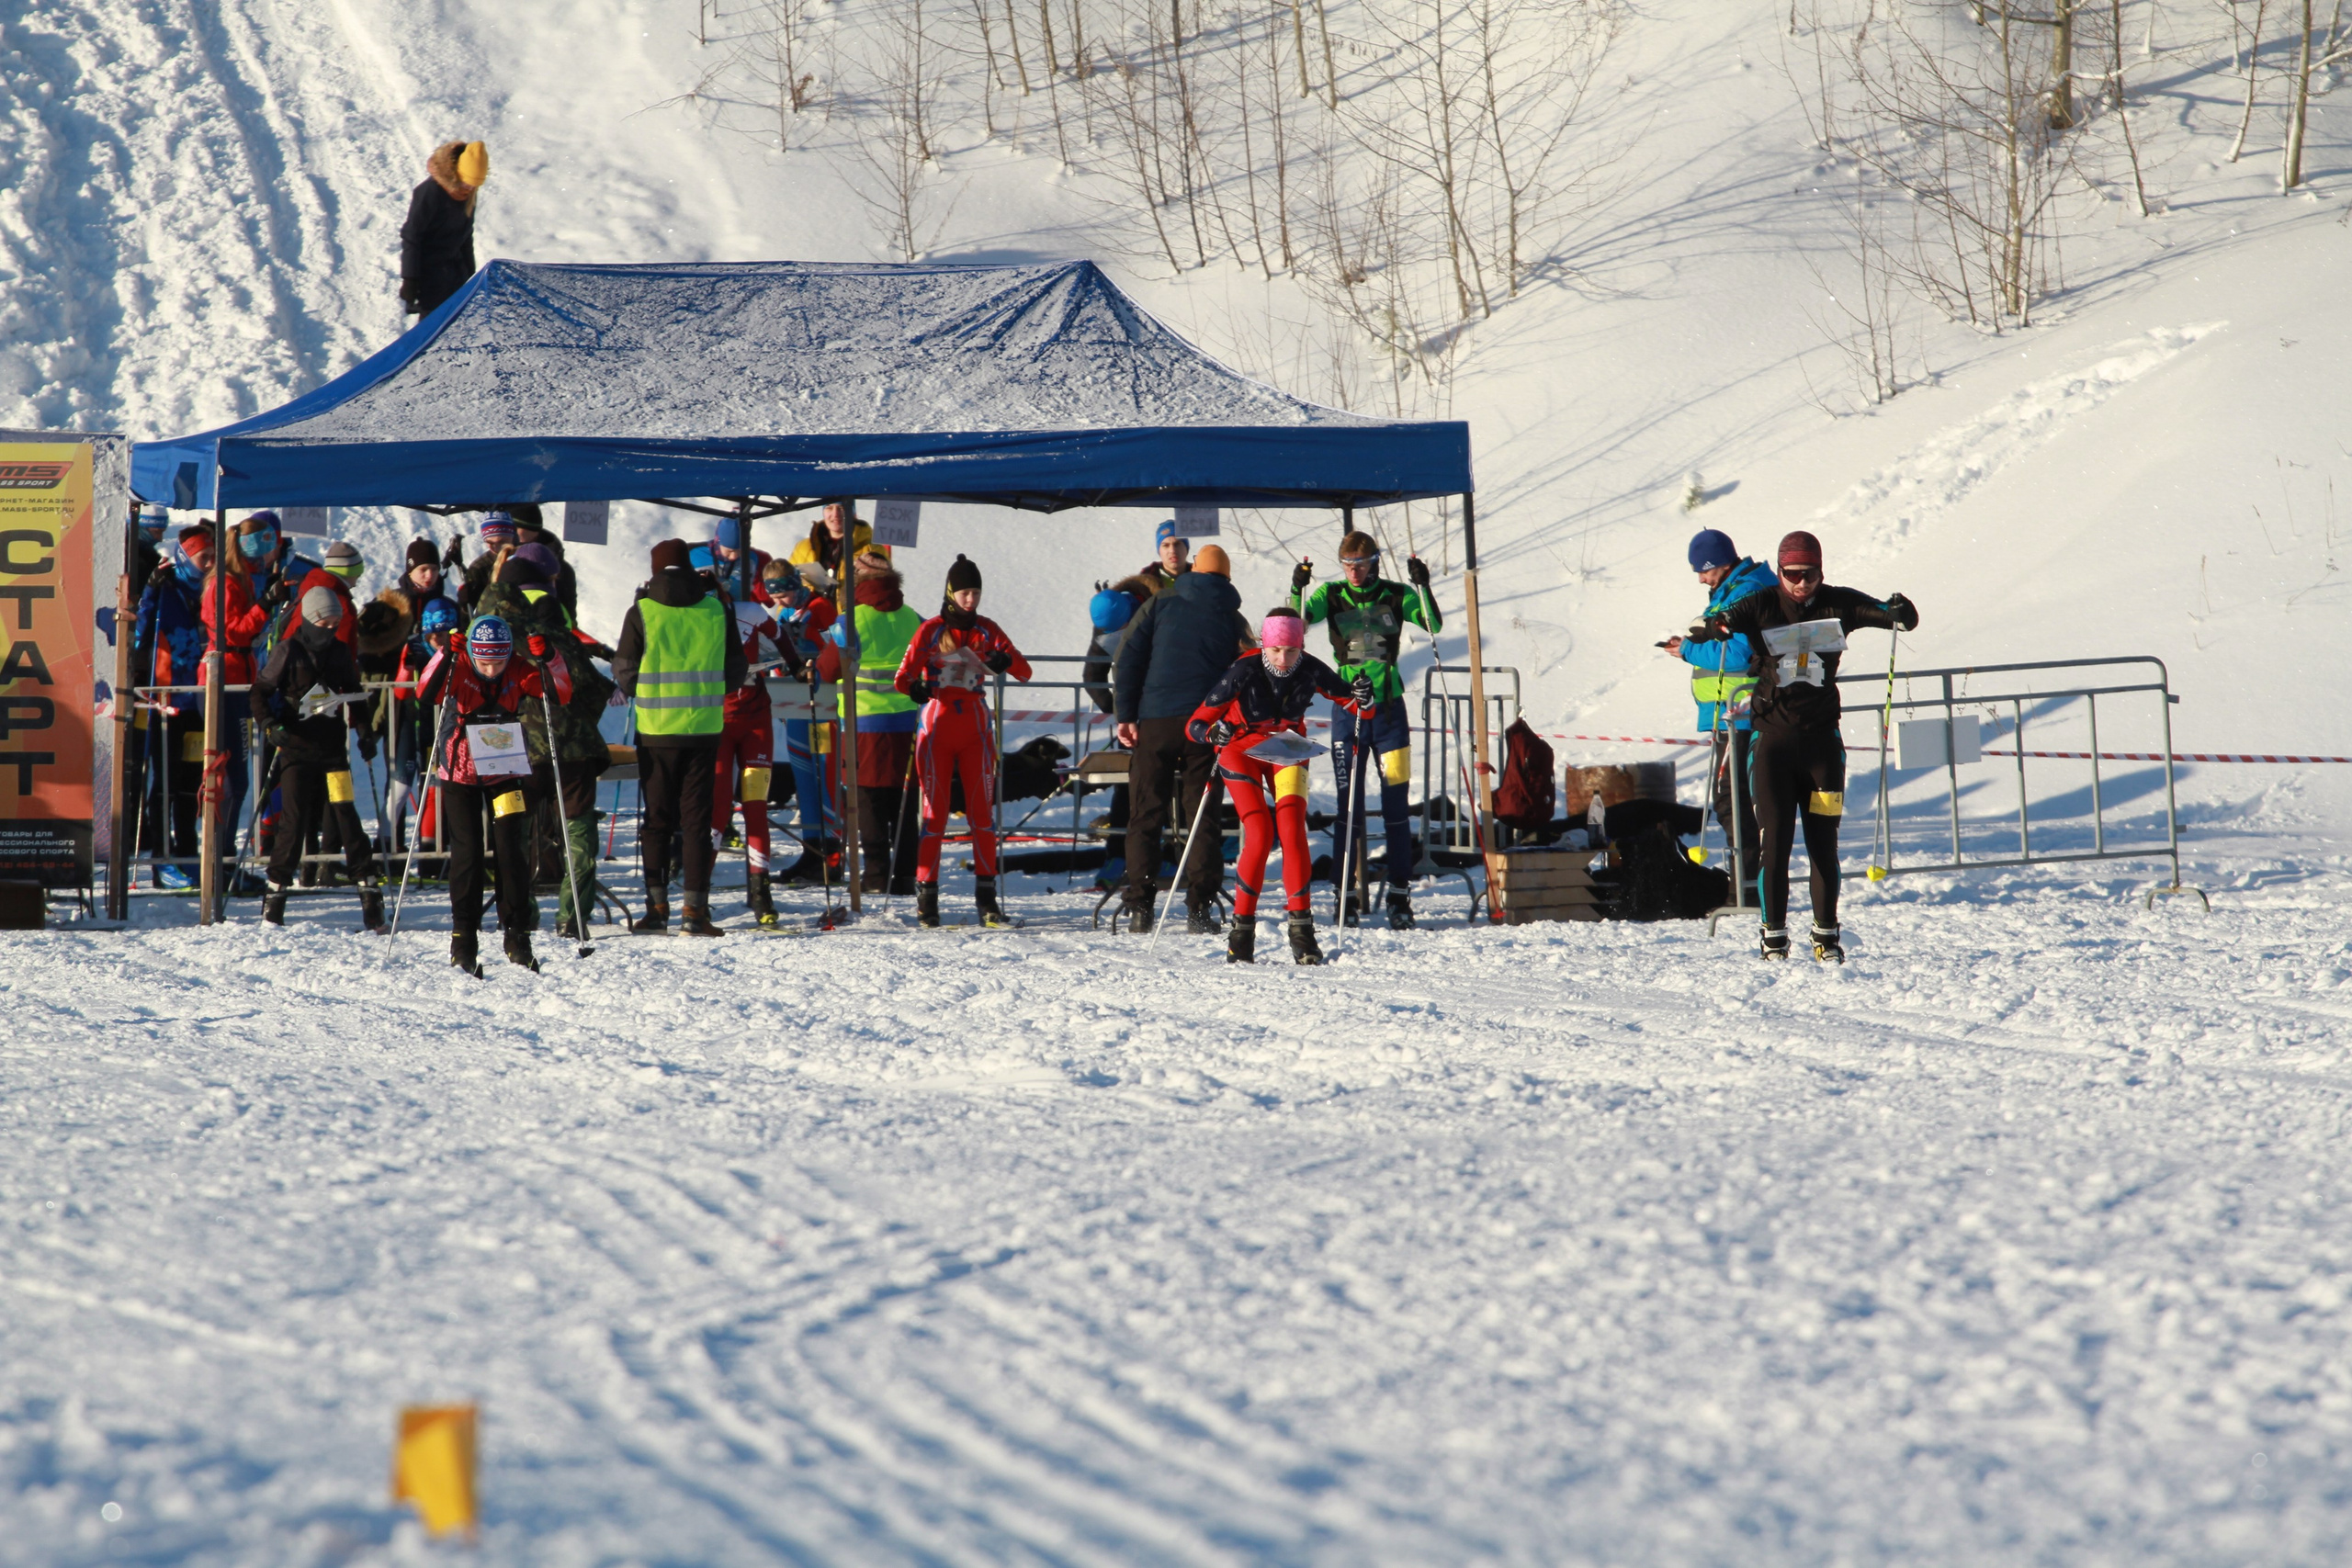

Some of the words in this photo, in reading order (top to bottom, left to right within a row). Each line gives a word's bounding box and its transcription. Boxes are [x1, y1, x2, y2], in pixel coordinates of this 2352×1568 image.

[0, 529, 55, 796] СТАРТ
[1334, 741, 1348, 789] RUSSIA
[514, 792, 521, 801] 5
[1834, 794, 1840, 804] 4
